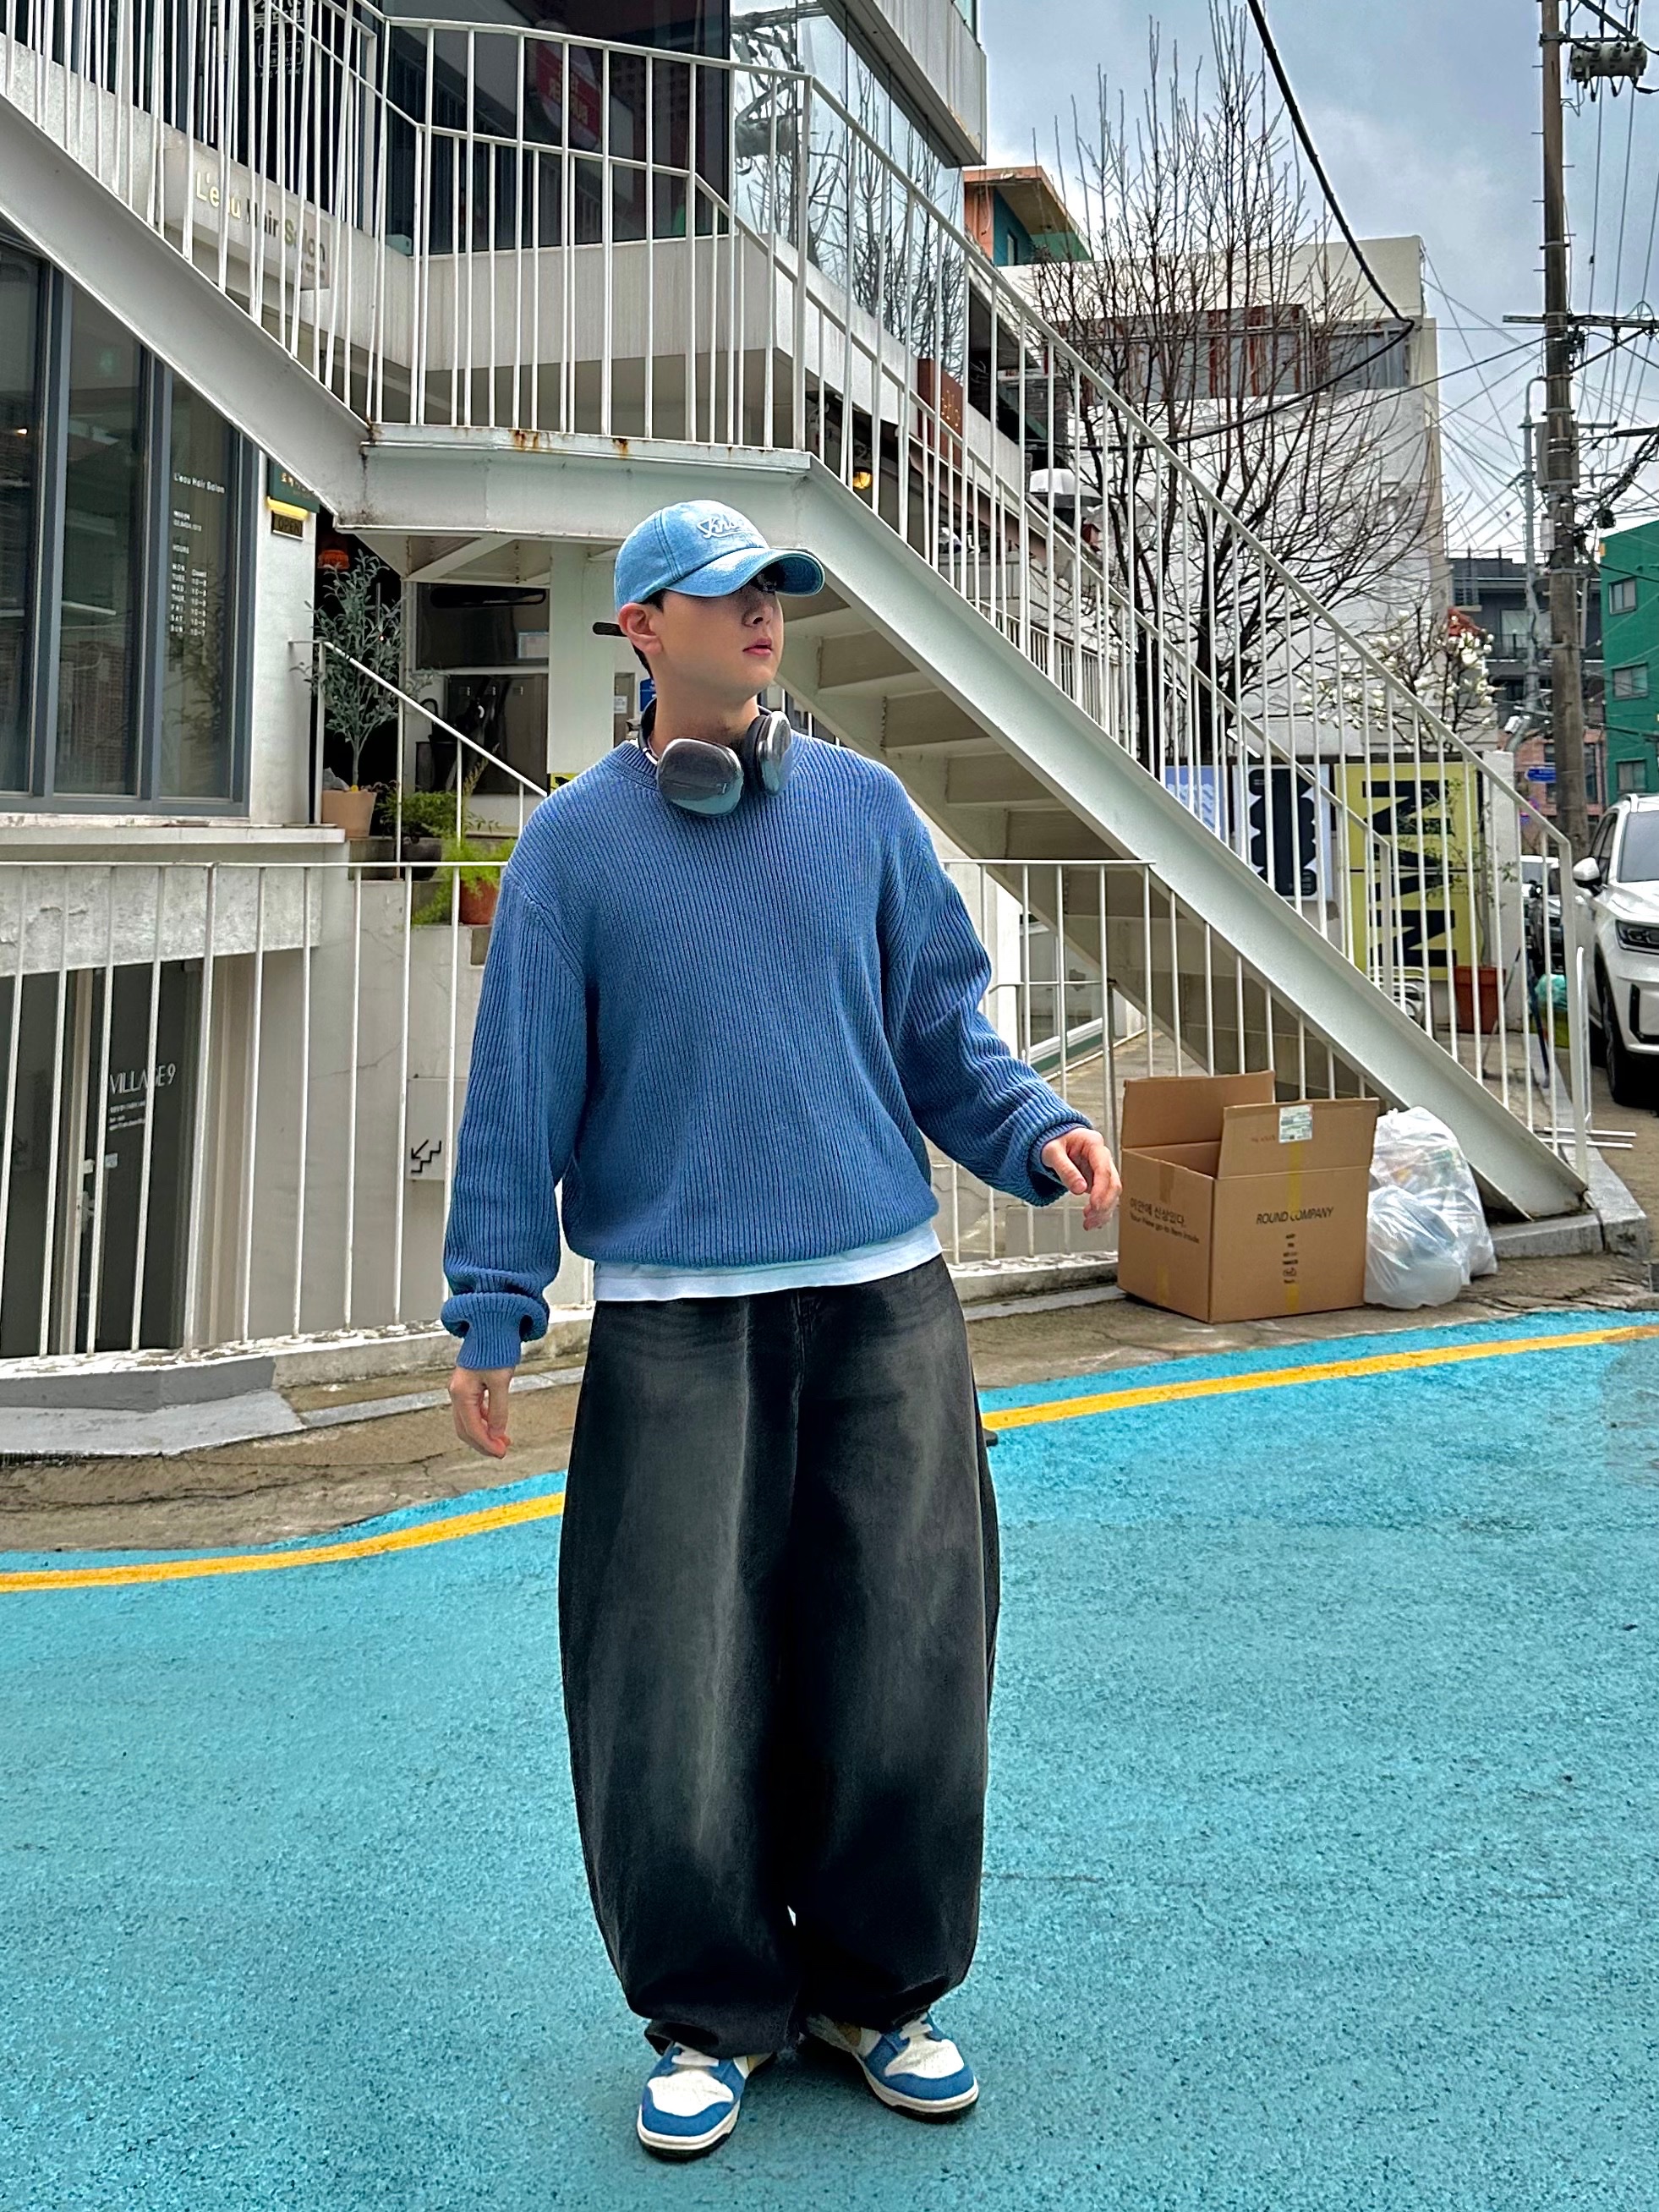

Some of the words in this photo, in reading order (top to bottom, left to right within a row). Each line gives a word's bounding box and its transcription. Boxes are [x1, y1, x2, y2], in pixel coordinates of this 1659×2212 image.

[196, 171, 241, 219] L'eu
[284, 218, 326, 262] Slon
[192, 477, 206, 489] Hair
[206, 481, 225, 494] Salon
[278, 515, 300, 534] OPEN
[110, 1063, 176, 1094] VILLAE9
[1256, 1211, 1289, 1224] ROUND
